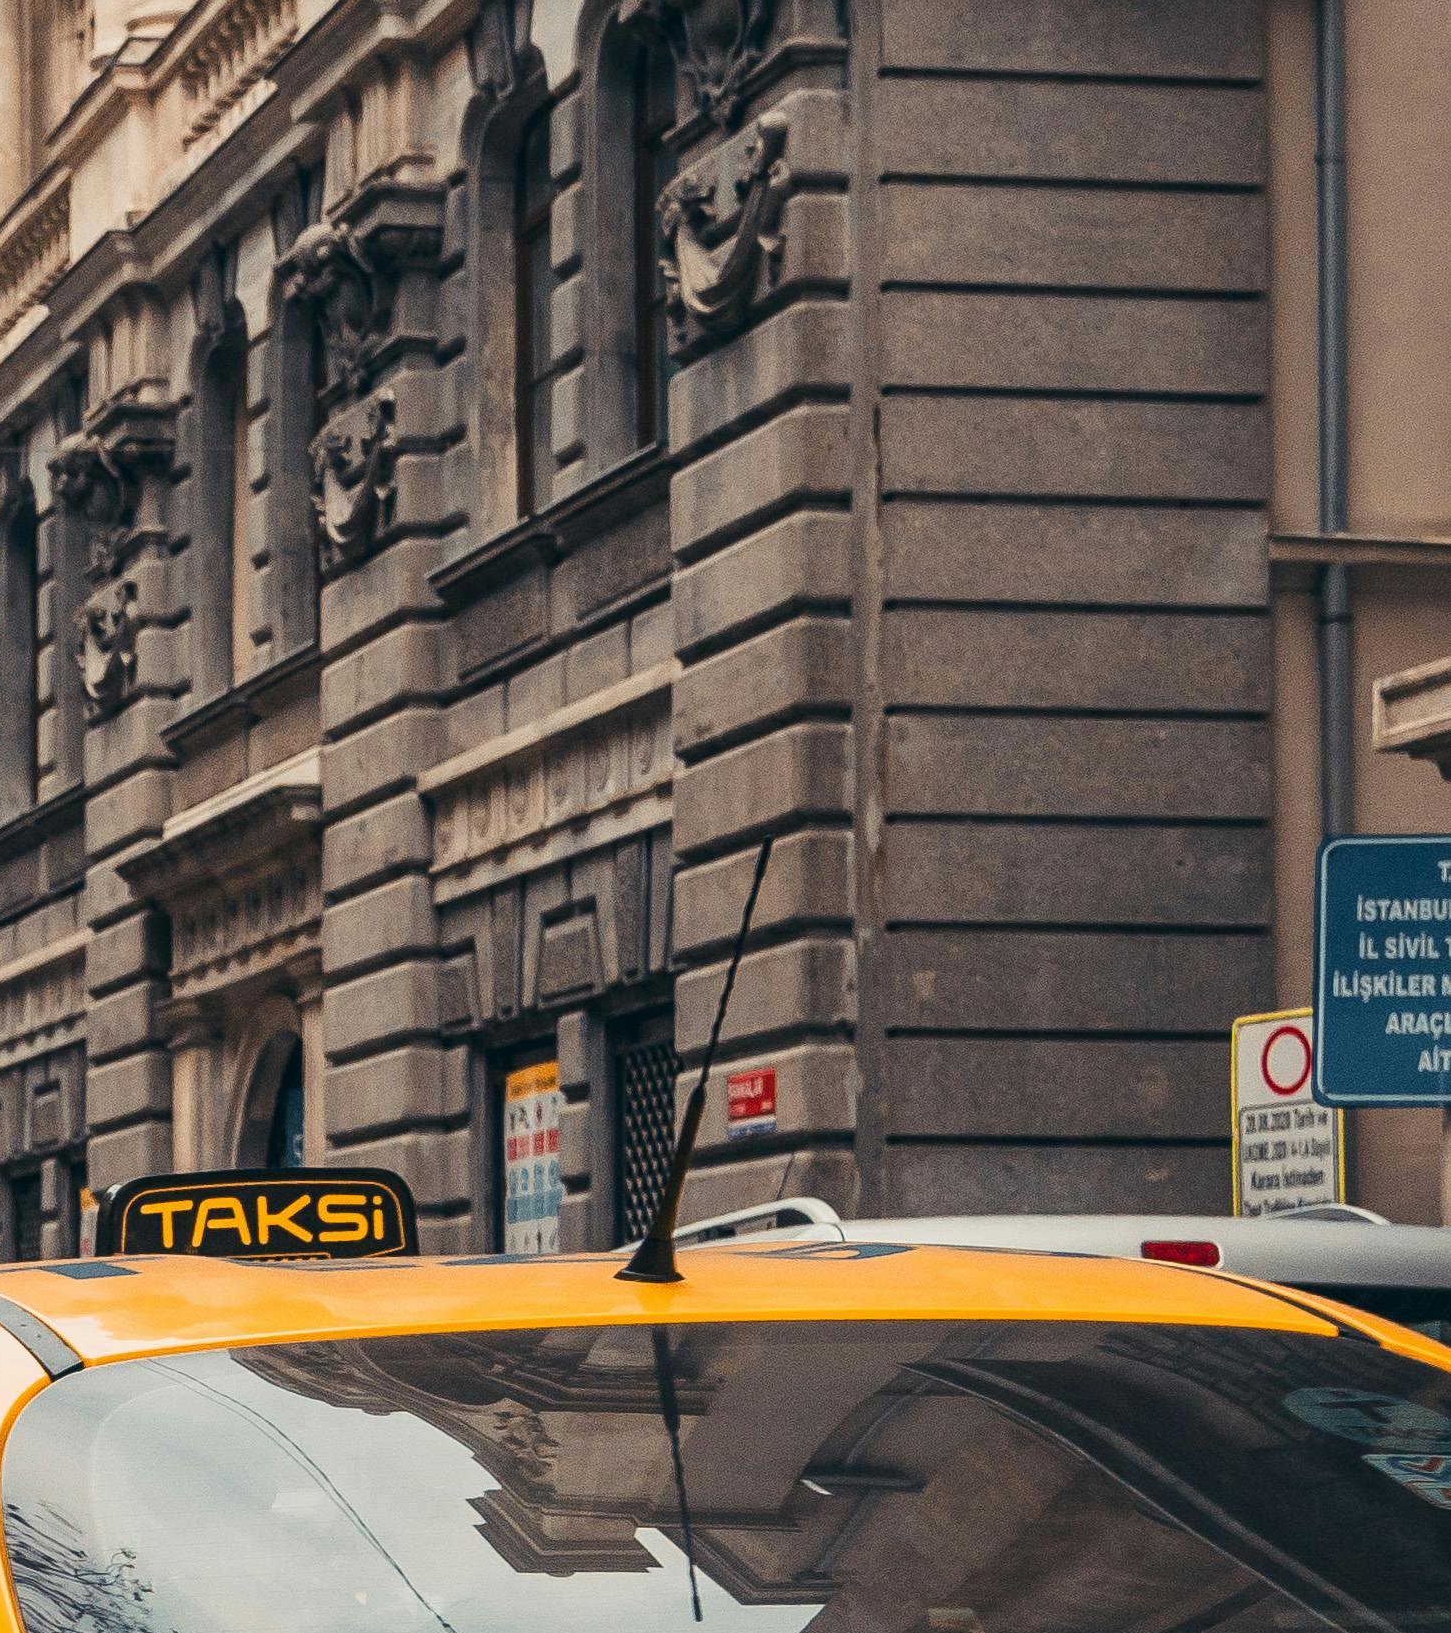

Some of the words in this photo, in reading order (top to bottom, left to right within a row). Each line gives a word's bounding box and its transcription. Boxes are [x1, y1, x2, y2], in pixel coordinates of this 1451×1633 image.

[1357, 894, 1451, 921] İSTANBU
[1385, 931, 1440, 960] SİVİL
[1333, 970, 1437, 1004] İLİŞKİLER
